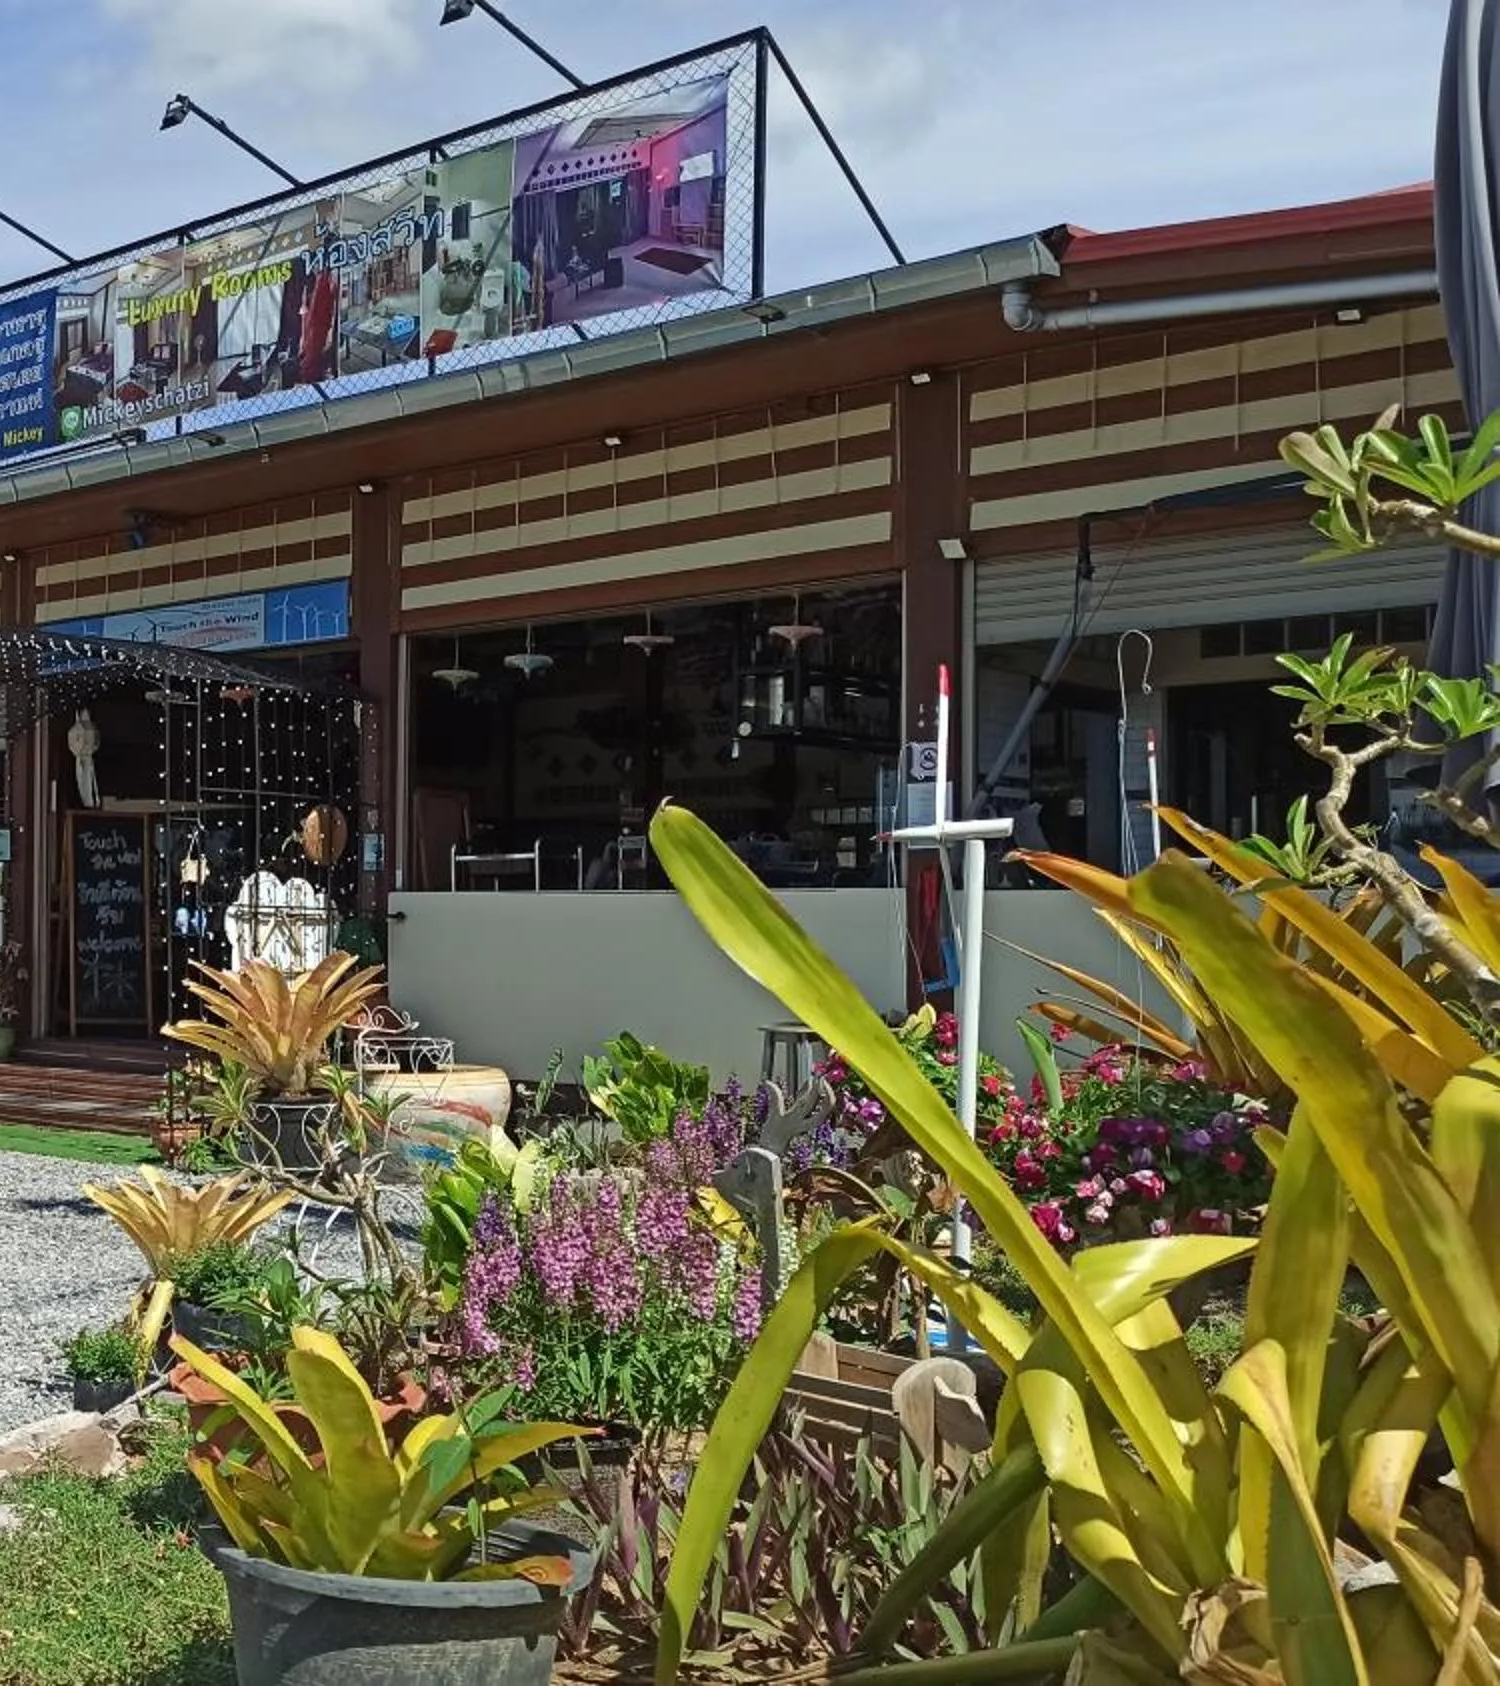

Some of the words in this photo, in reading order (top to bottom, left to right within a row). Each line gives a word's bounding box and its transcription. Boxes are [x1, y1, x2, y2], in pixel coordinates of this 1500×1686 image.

[301, 206, 445, 276] ห้องสวีท
[127, 285, 201, 327] Luxury
[211, 261, 292, 302] Rooms
[83, 375, 209, 429] Mickeyschatzi
[225, 612, 259, 624] Wind
[79, 829, 127, 850] Touch
